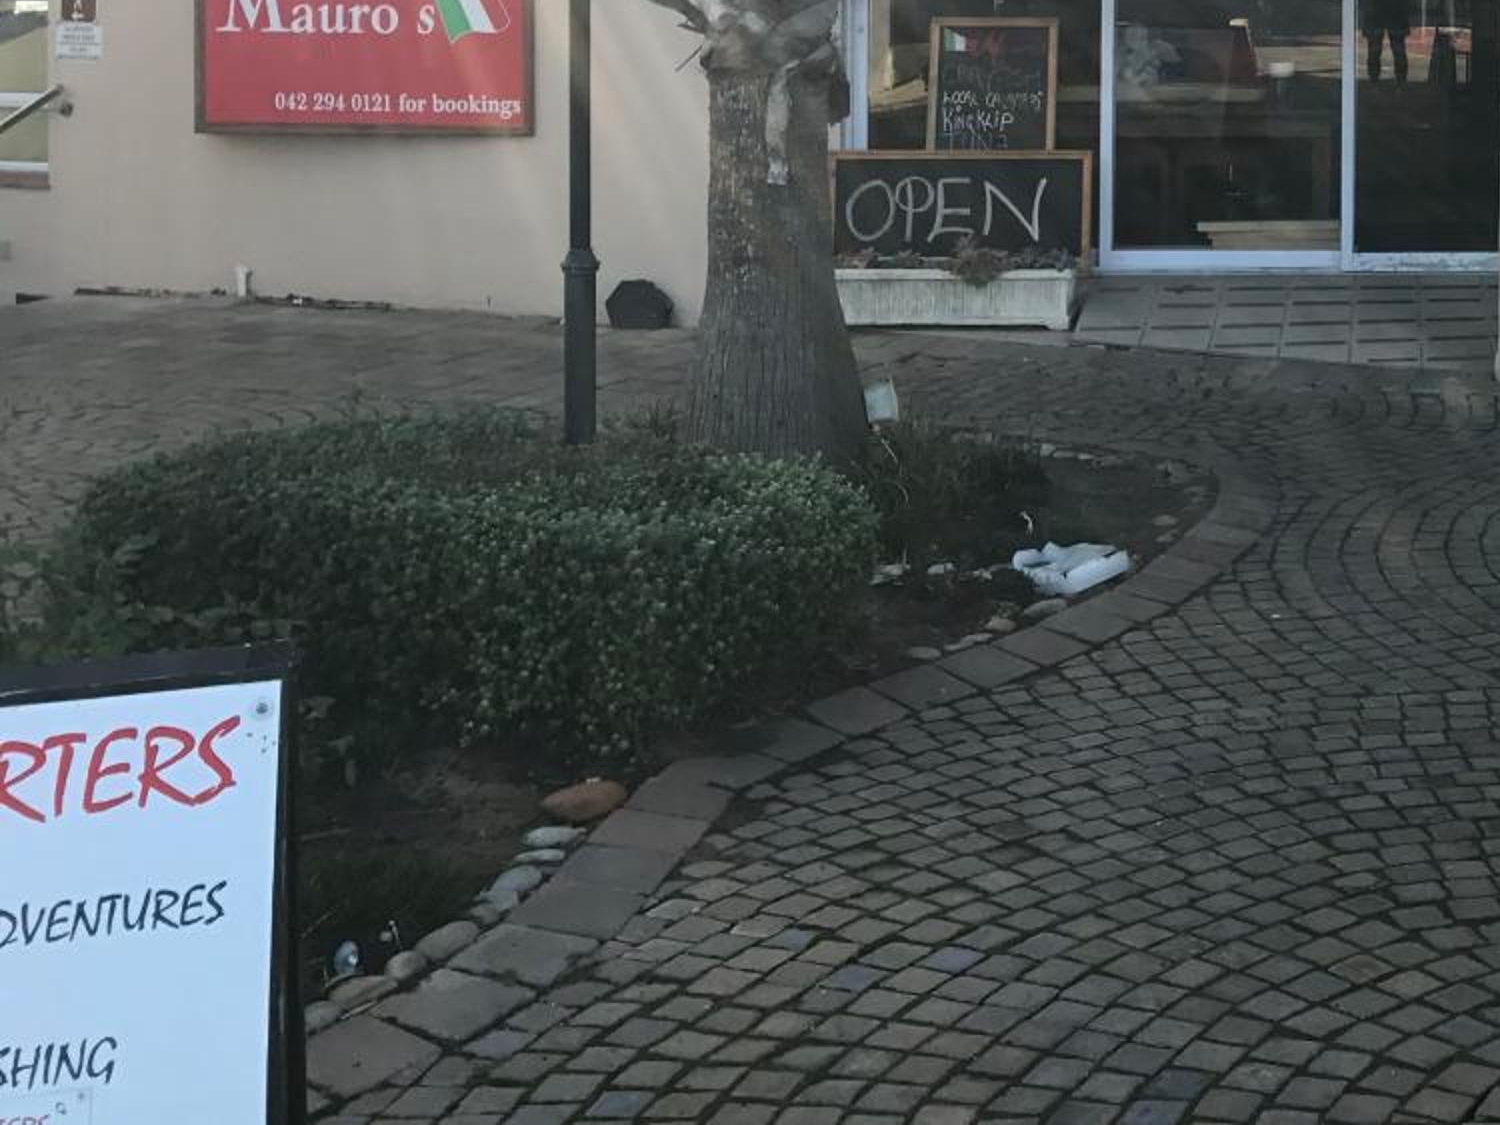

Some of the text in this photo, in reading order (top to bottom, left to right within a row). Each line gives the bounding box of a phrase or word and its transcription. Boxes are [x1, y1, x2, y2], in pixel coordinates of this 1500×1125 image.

[275, 92, 521, 120] 042 294 0121 for bookings
[845, 175, 1048, 243] OPEN
